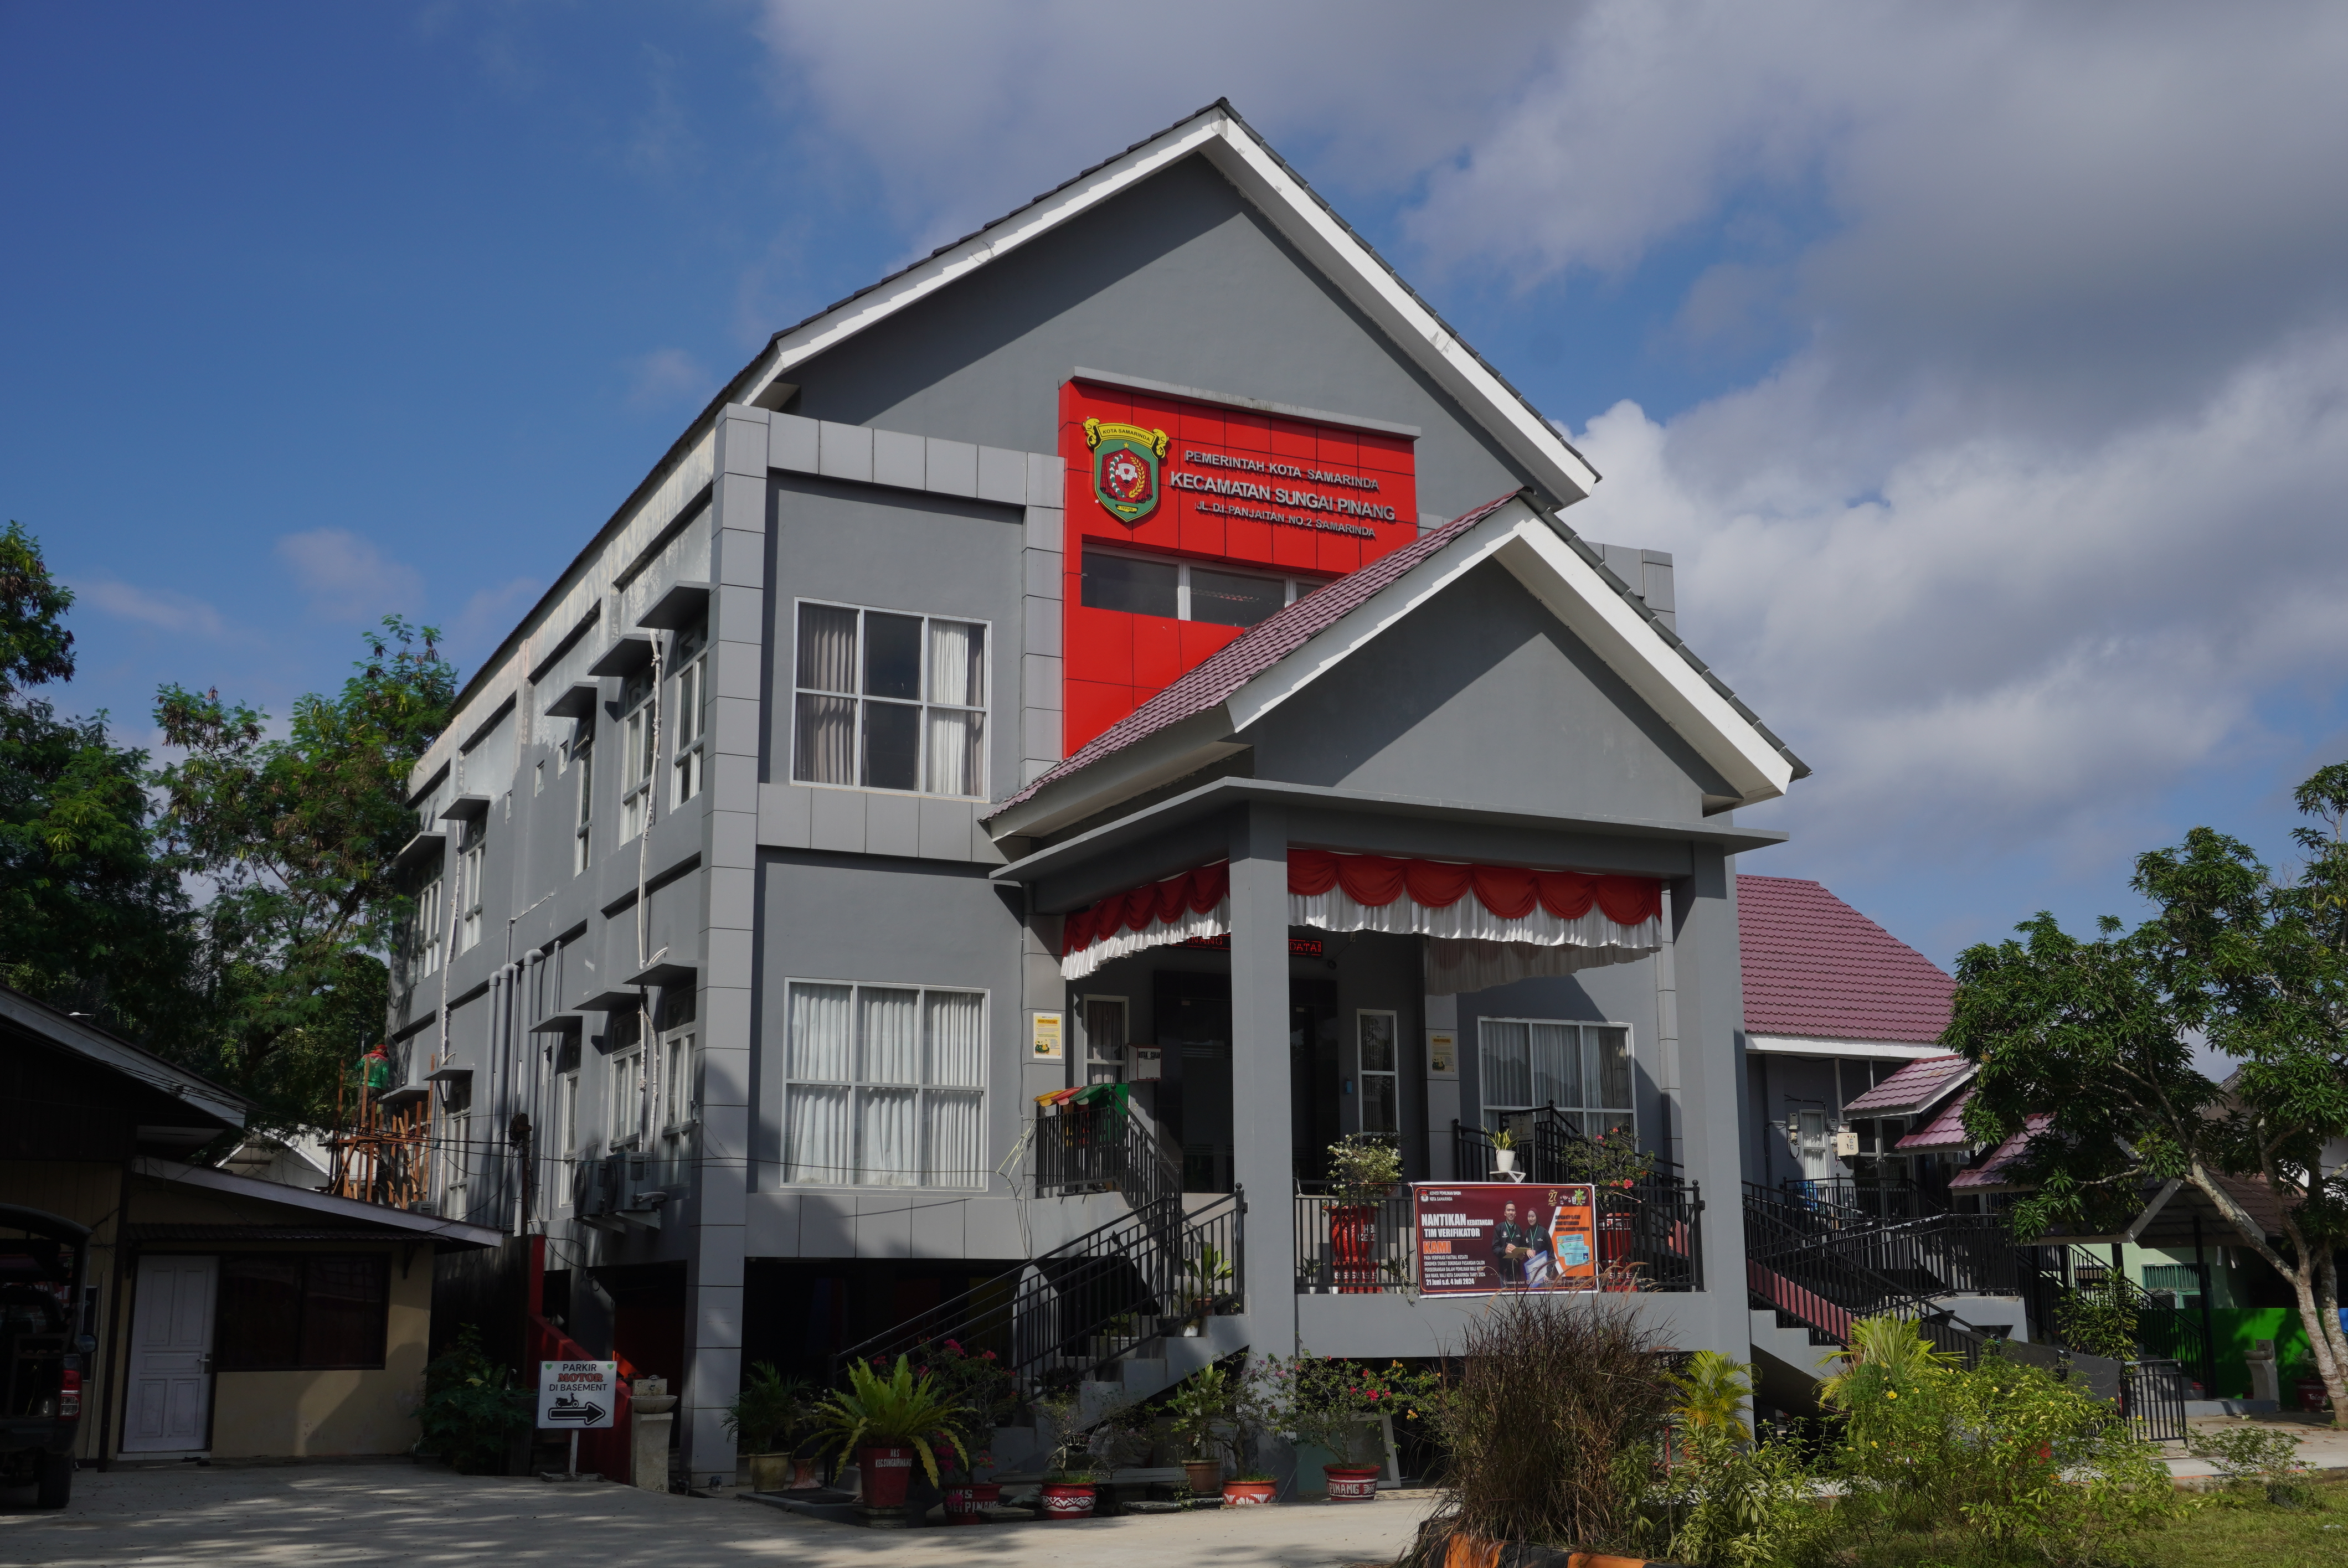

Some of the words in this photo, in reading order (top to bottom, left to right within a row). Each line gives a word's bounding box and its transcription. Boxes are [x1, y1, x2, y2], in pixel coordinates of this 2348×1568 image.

[1119, 429, 1150, 442] SAMARINDA
[1185, 450, 1264, 472] PEMERINTAH
[1269, 463, 1301, 477] KOTA
[1307, 469, 1379, 489] SAMARINDA
[1170, 471, 1270, 500] KECAMATAN
[1275, 488, 1333, 510] SUNGAI
[1337, 498, 1395, 520] PINANG
[1196, 501, 1211, 511] JL.
[1228, 505, 1285, 523] PANJAITAN
[1316, 519, 1376, 537] SAMARINDA
[1548, 1192, 1558, 1203] 27
[1422, 1214, 1466, 1226] NANTIKAN
[1424, 1228, 1437, 1237] TIM
[1438, 1227, 1480, 1237] VERIFIKATOR
[1423, 1241, 1451, 1254] KAMI
[557, 1373, 604, 1383] MOTOR
[1329, 1482, 1360, 1494] PINANG
